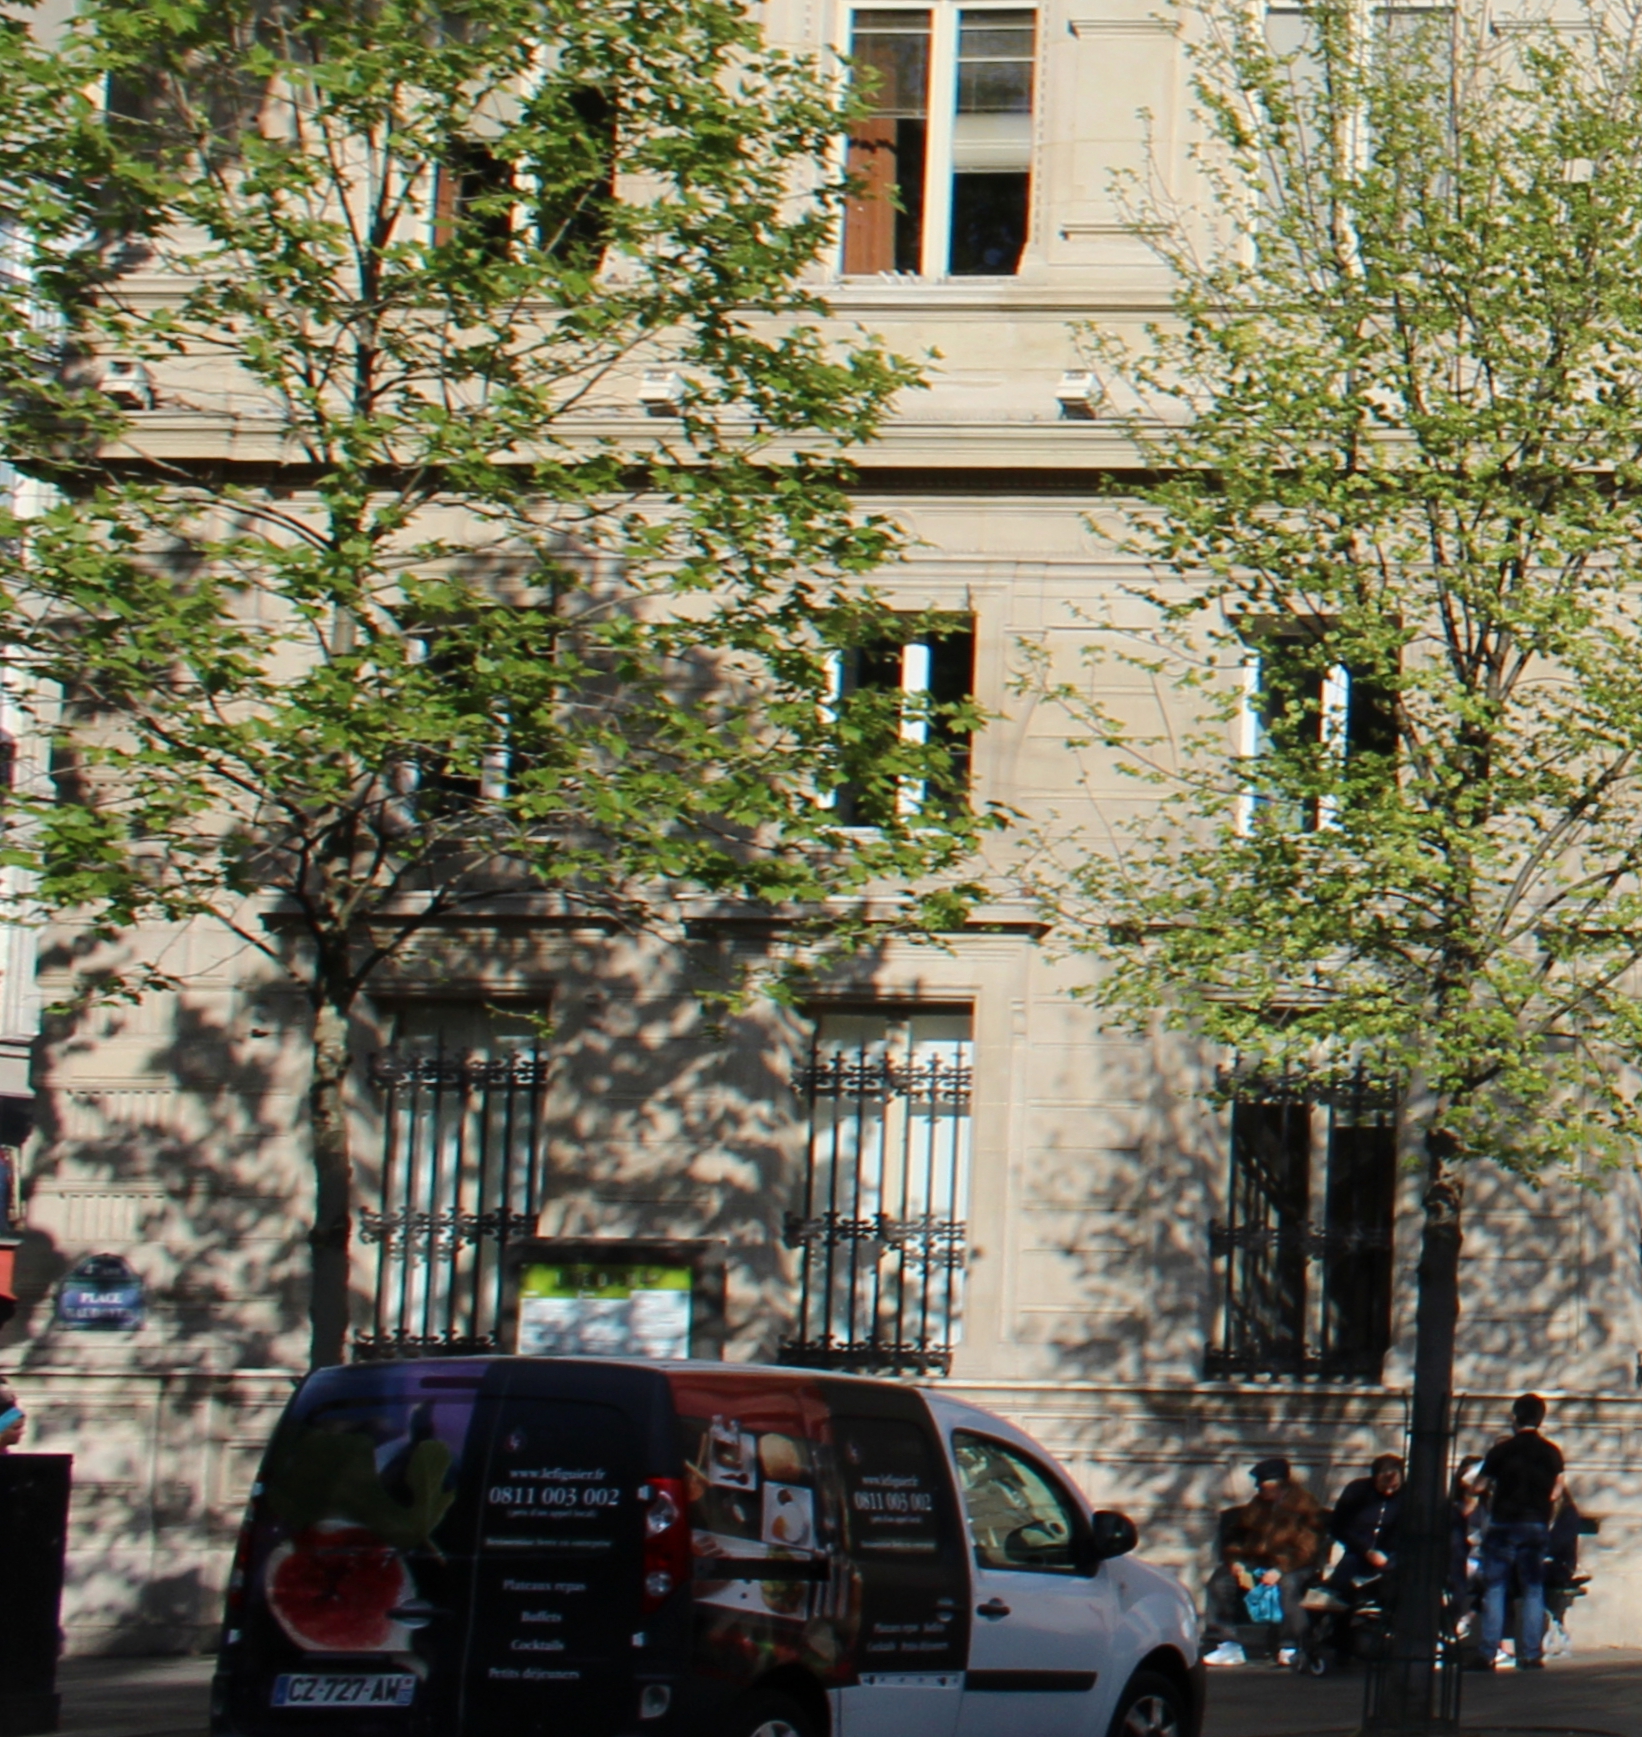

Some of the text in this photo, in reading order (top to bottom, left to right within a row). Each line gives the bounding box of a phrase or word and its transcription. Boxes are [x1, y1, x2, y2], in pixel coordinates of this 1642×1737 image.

[80, 1292, 123, 1304] PLACE
[489, 1486, 620, 1506] 0811 003 002
[854, 1491, 884, 1510] 0811
[910, 1492, 932, 1510] 002
[510, 1639, 566, 1651] Cocktails
[288, 1677, 402, 1702] CZ-727-AW
